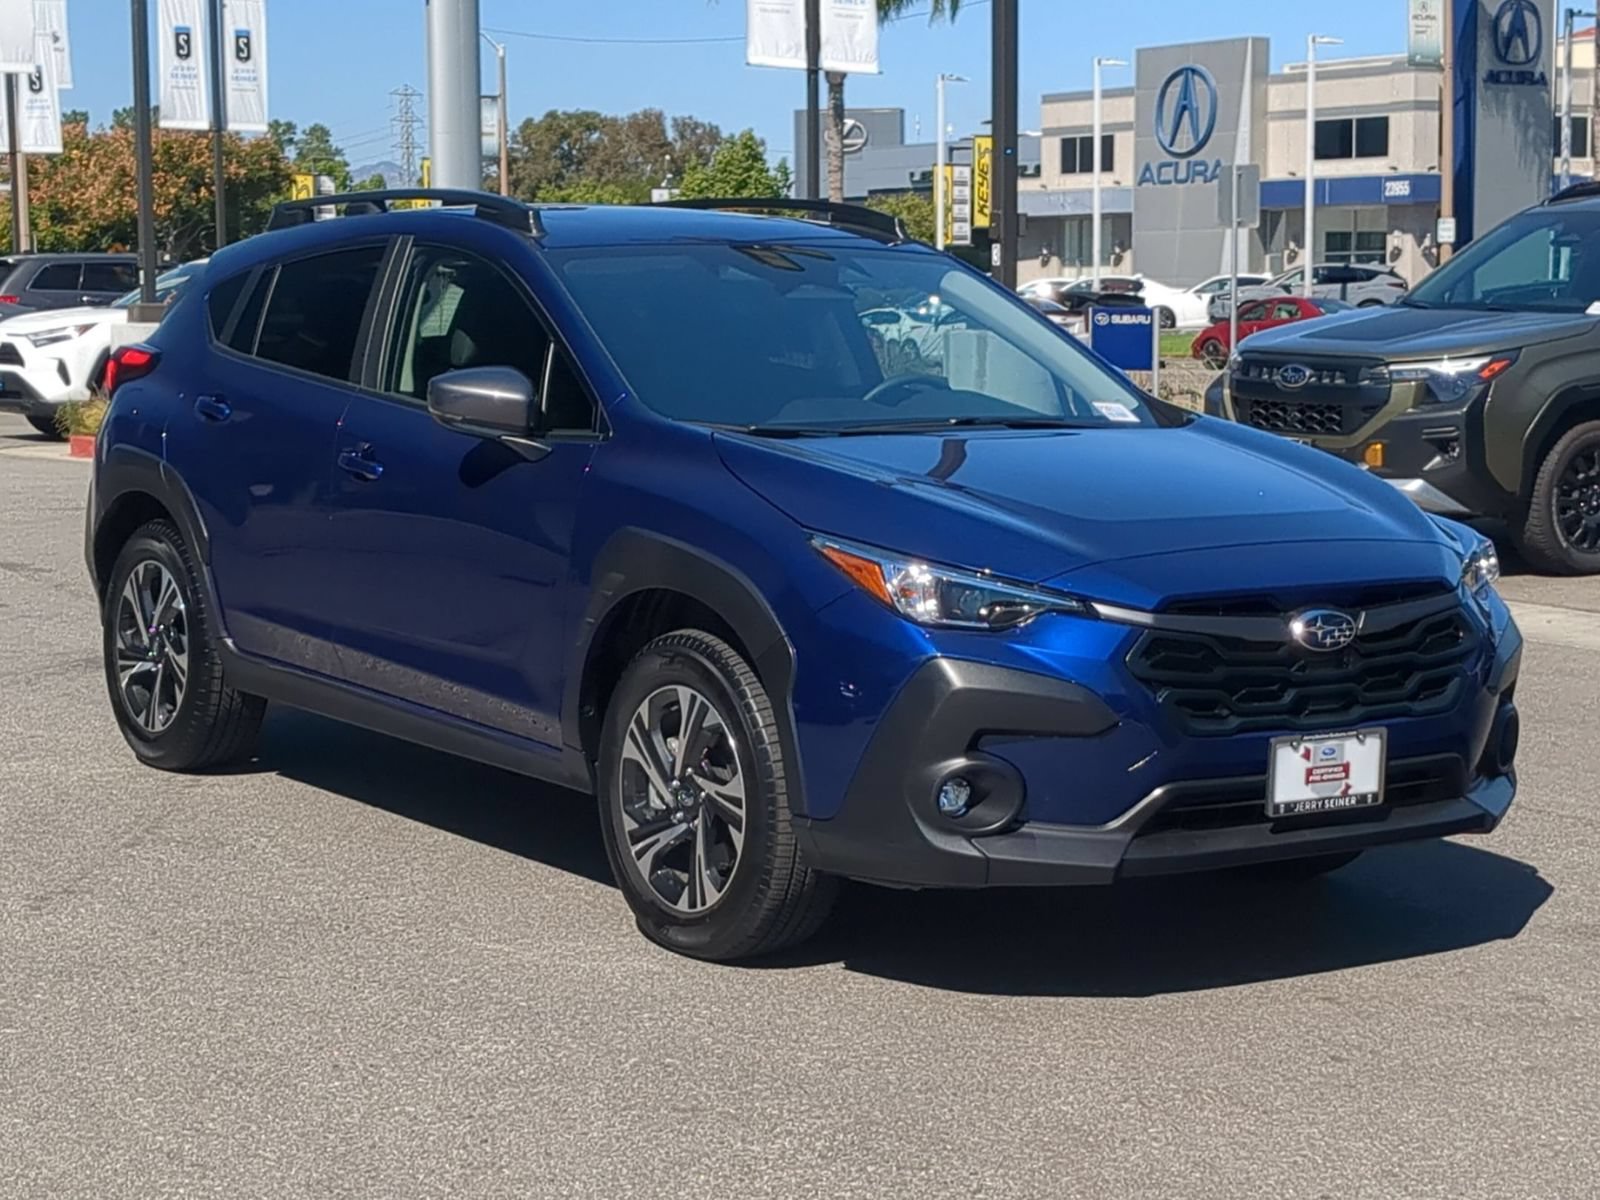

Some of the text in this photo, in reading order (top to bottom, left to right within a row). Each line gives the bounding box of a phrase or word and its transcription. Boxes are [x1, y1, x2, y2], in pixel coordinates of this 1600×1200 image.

[1484, 70, 1549, 86] ACURA
[977, 143, 991, 218] KEYES
[1137, 159, 1222, 187] ACURA
[1111, 314, 1151, 325] SUBARU
[1294, 796, 1357, 813] JERRY SEINER
